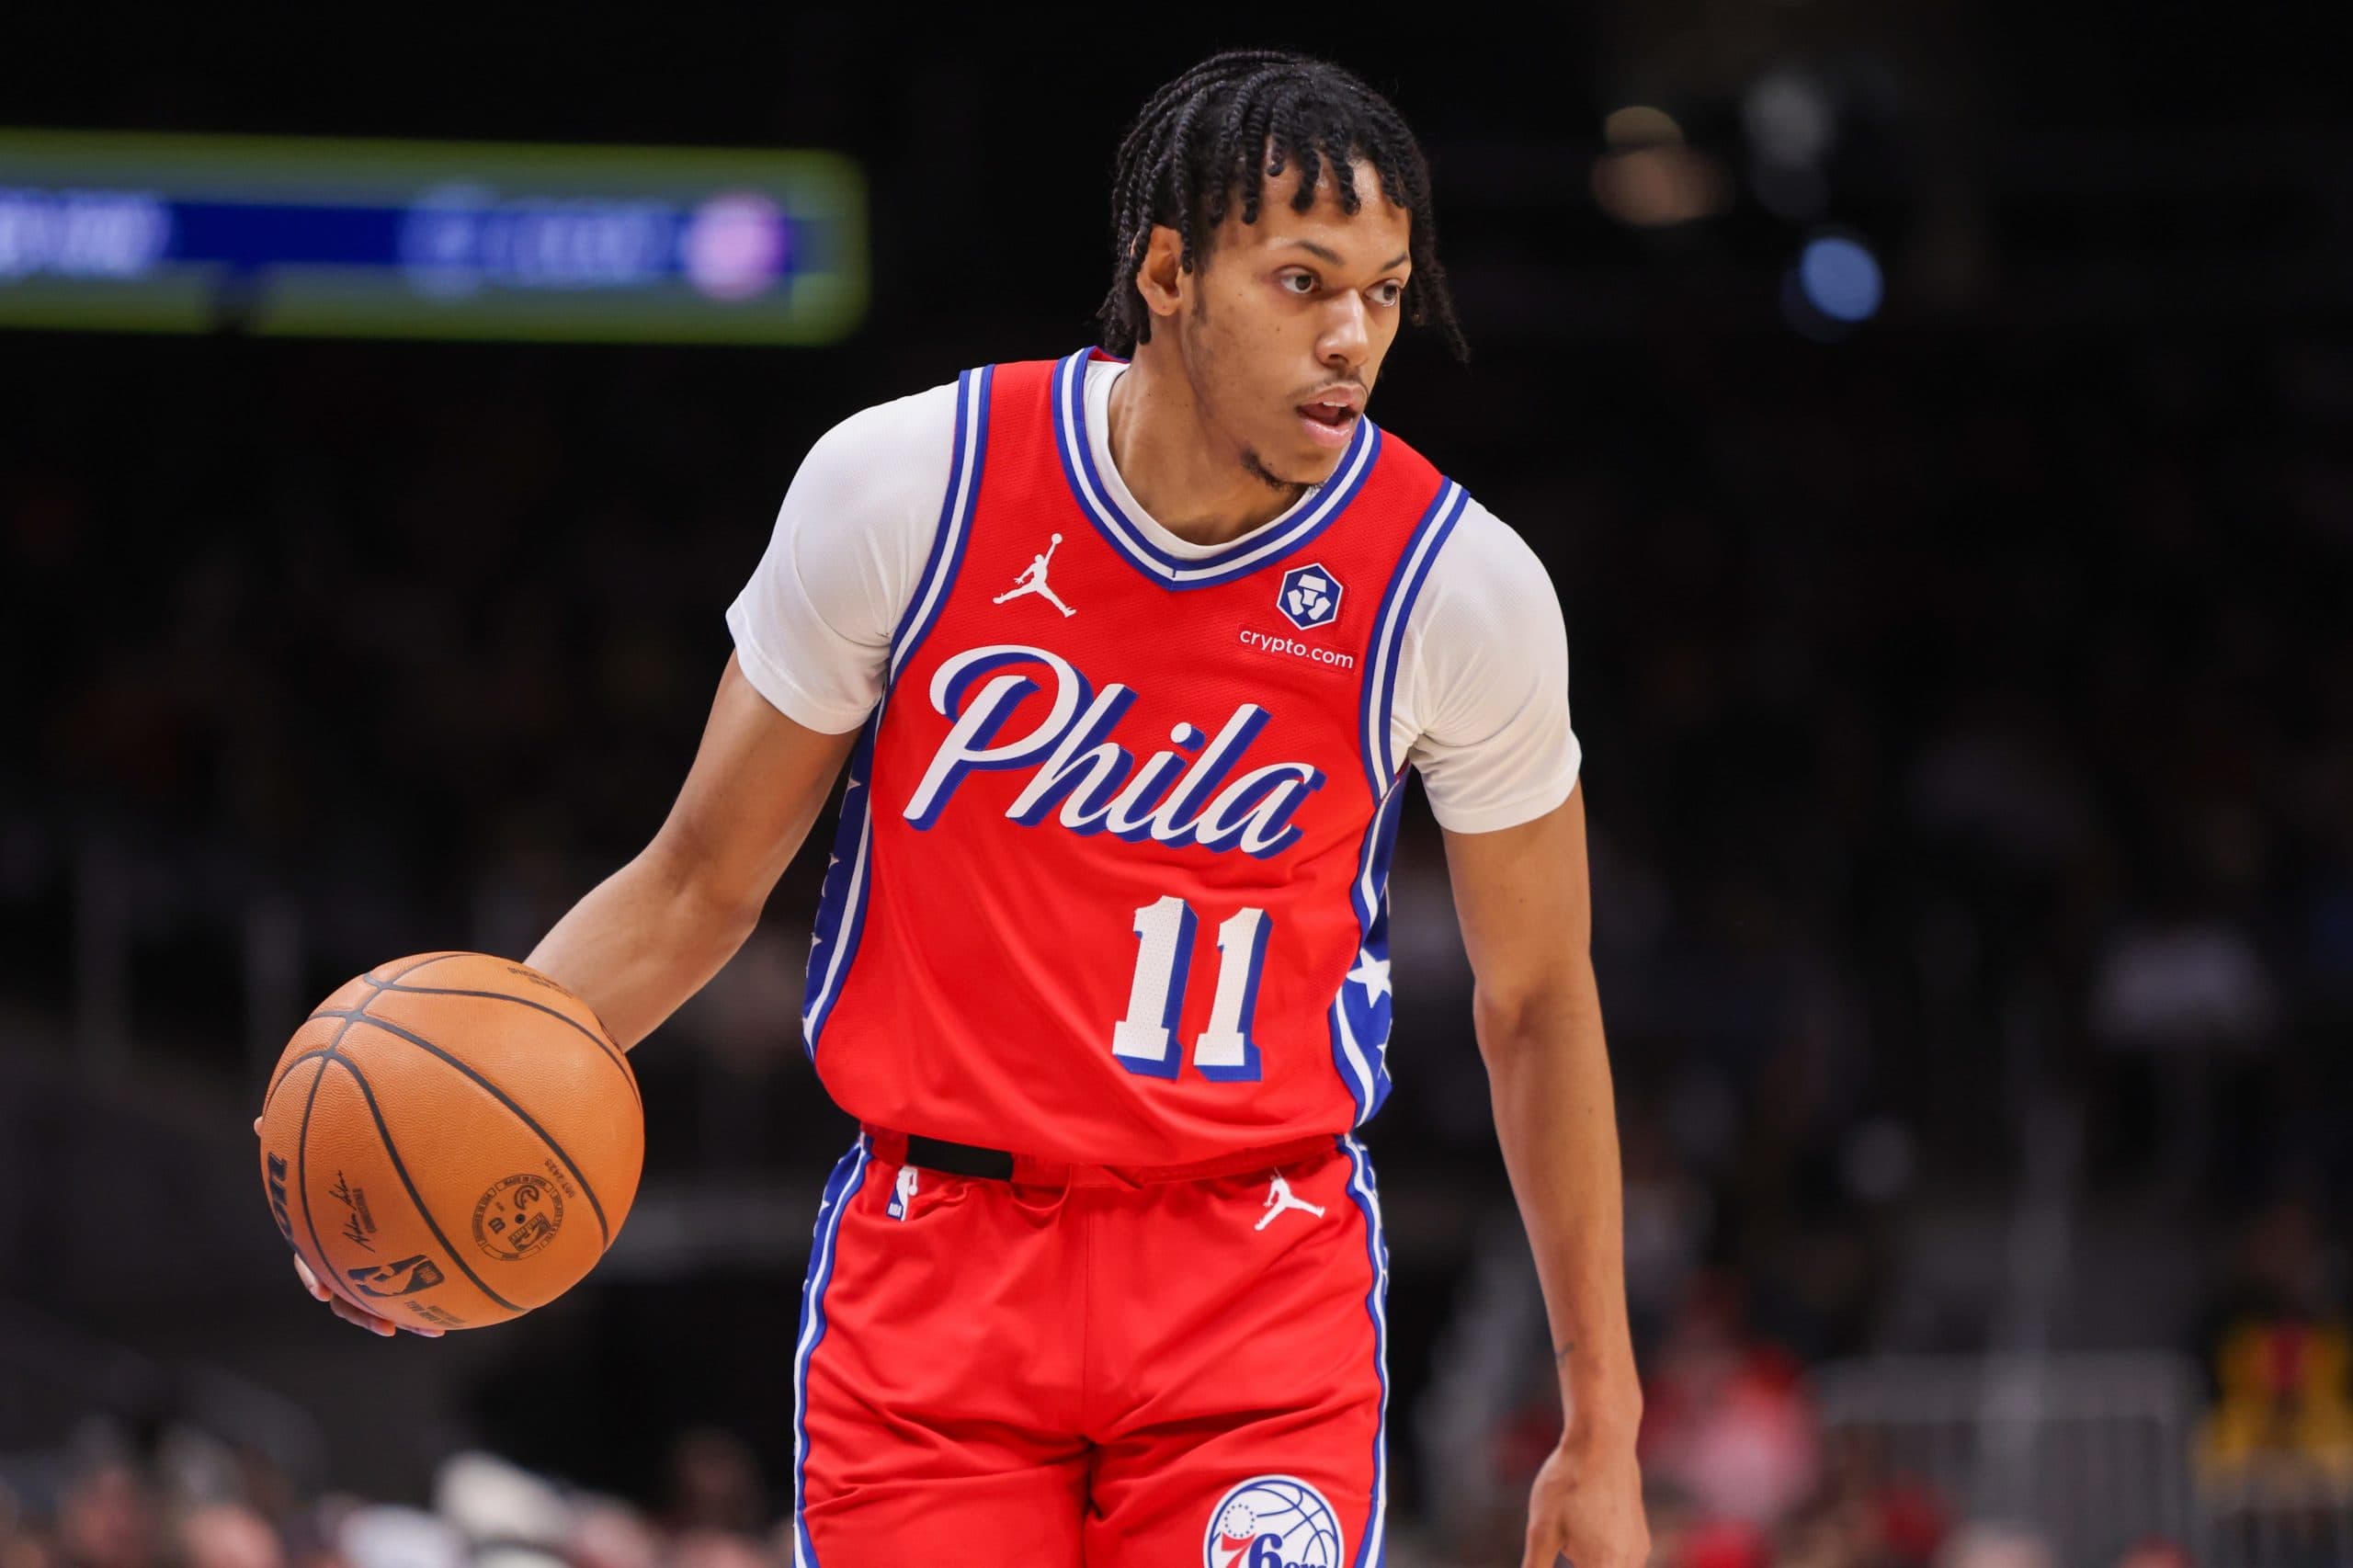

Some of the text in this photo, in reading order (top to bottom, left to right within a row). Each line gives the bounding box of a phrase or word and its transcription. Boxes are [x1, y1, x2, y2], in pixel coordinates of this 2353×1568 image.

[1239, 630, 1355, 669] crypto.com
[902, 643, 1326, 860] Phila
[1111, 894, 1273, 1083] 11
